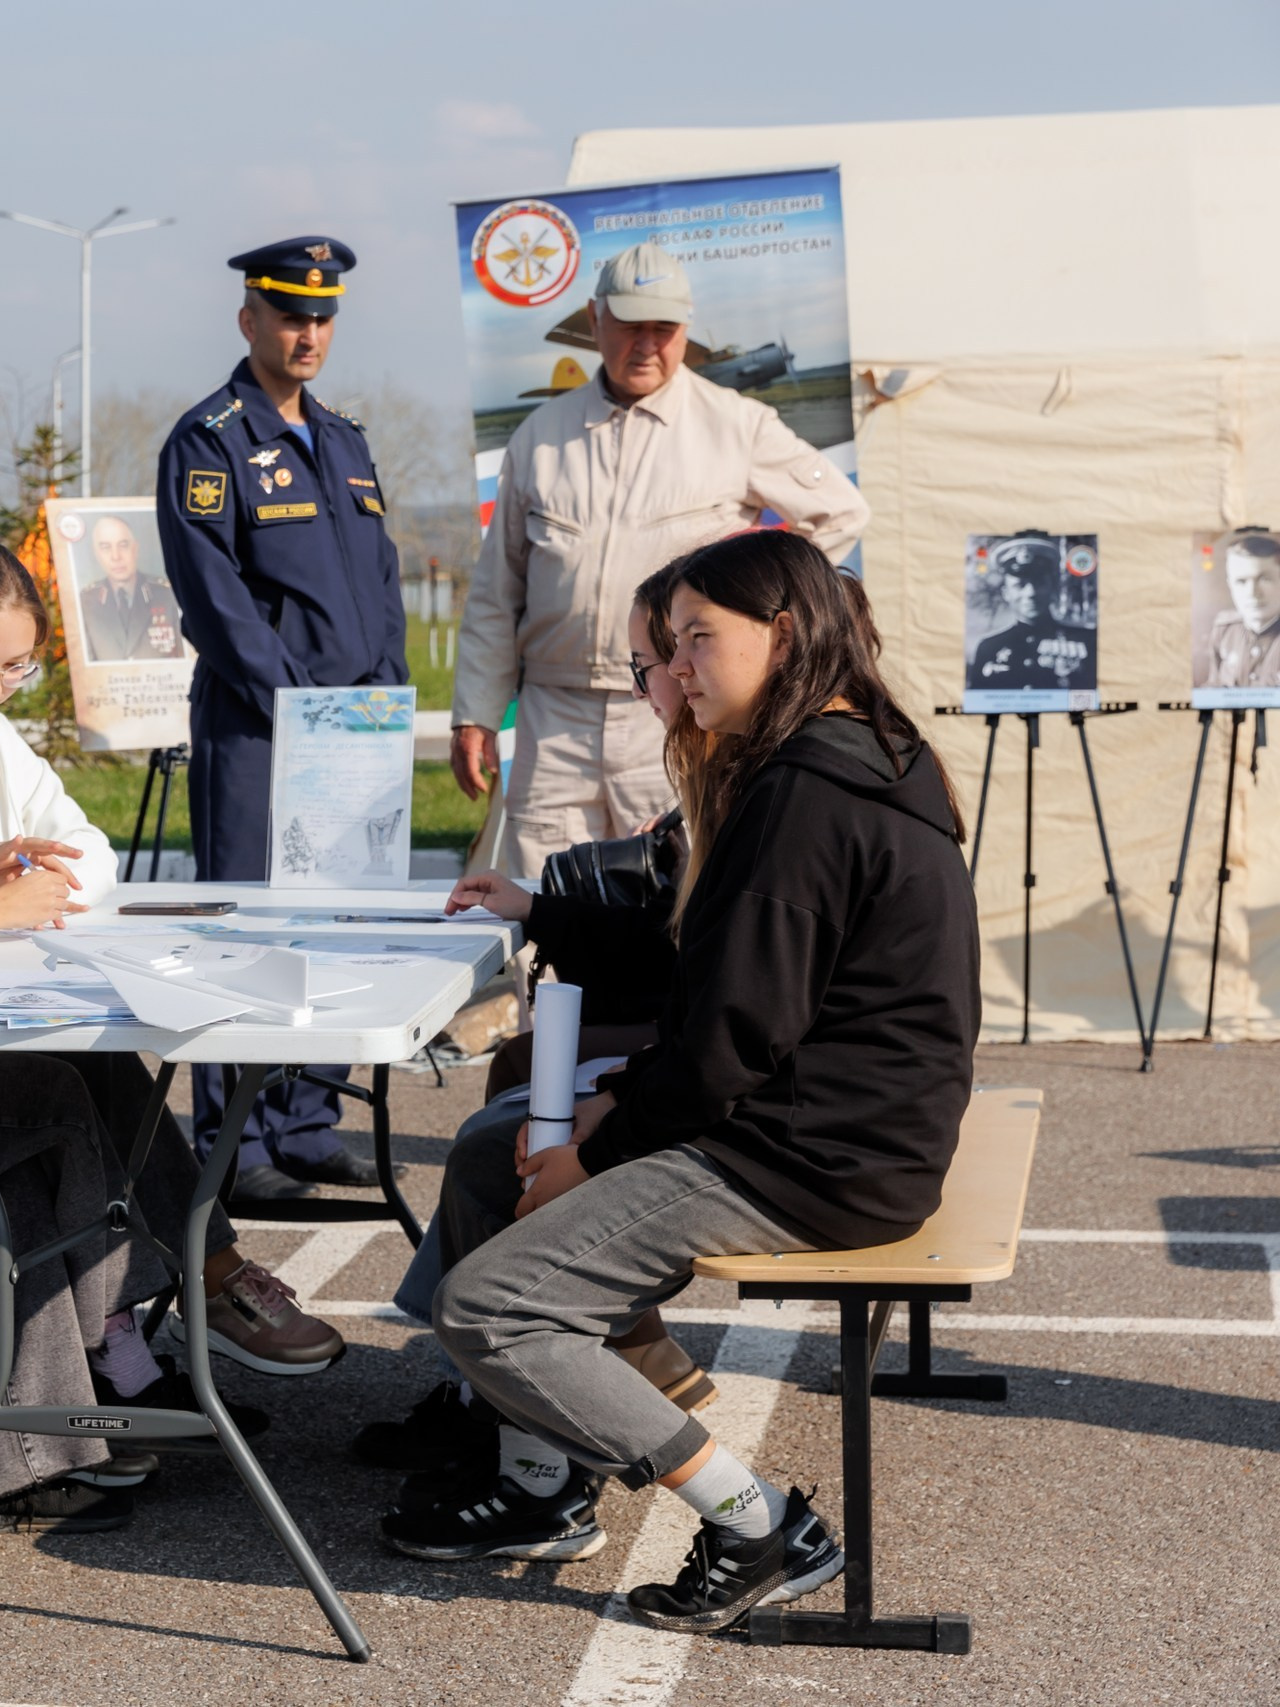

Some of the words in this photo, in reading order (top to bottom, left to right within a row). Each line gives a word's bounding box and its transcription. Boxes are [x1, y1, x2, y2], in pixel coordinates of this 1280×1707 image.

[595, 207, 724, 231] РЕГИОНАЛЬНОЕ
[729, 196, 823, 217] ОТДЕЛЕНИЕ
[649, 228, 714, 246] ДОСААФ
[720, 221, 785, 238] РОССИИ
[703, 238, 832, 262] БАШКОРТОСТАН
[74, 1418, 124, 1428] LIFETIME
